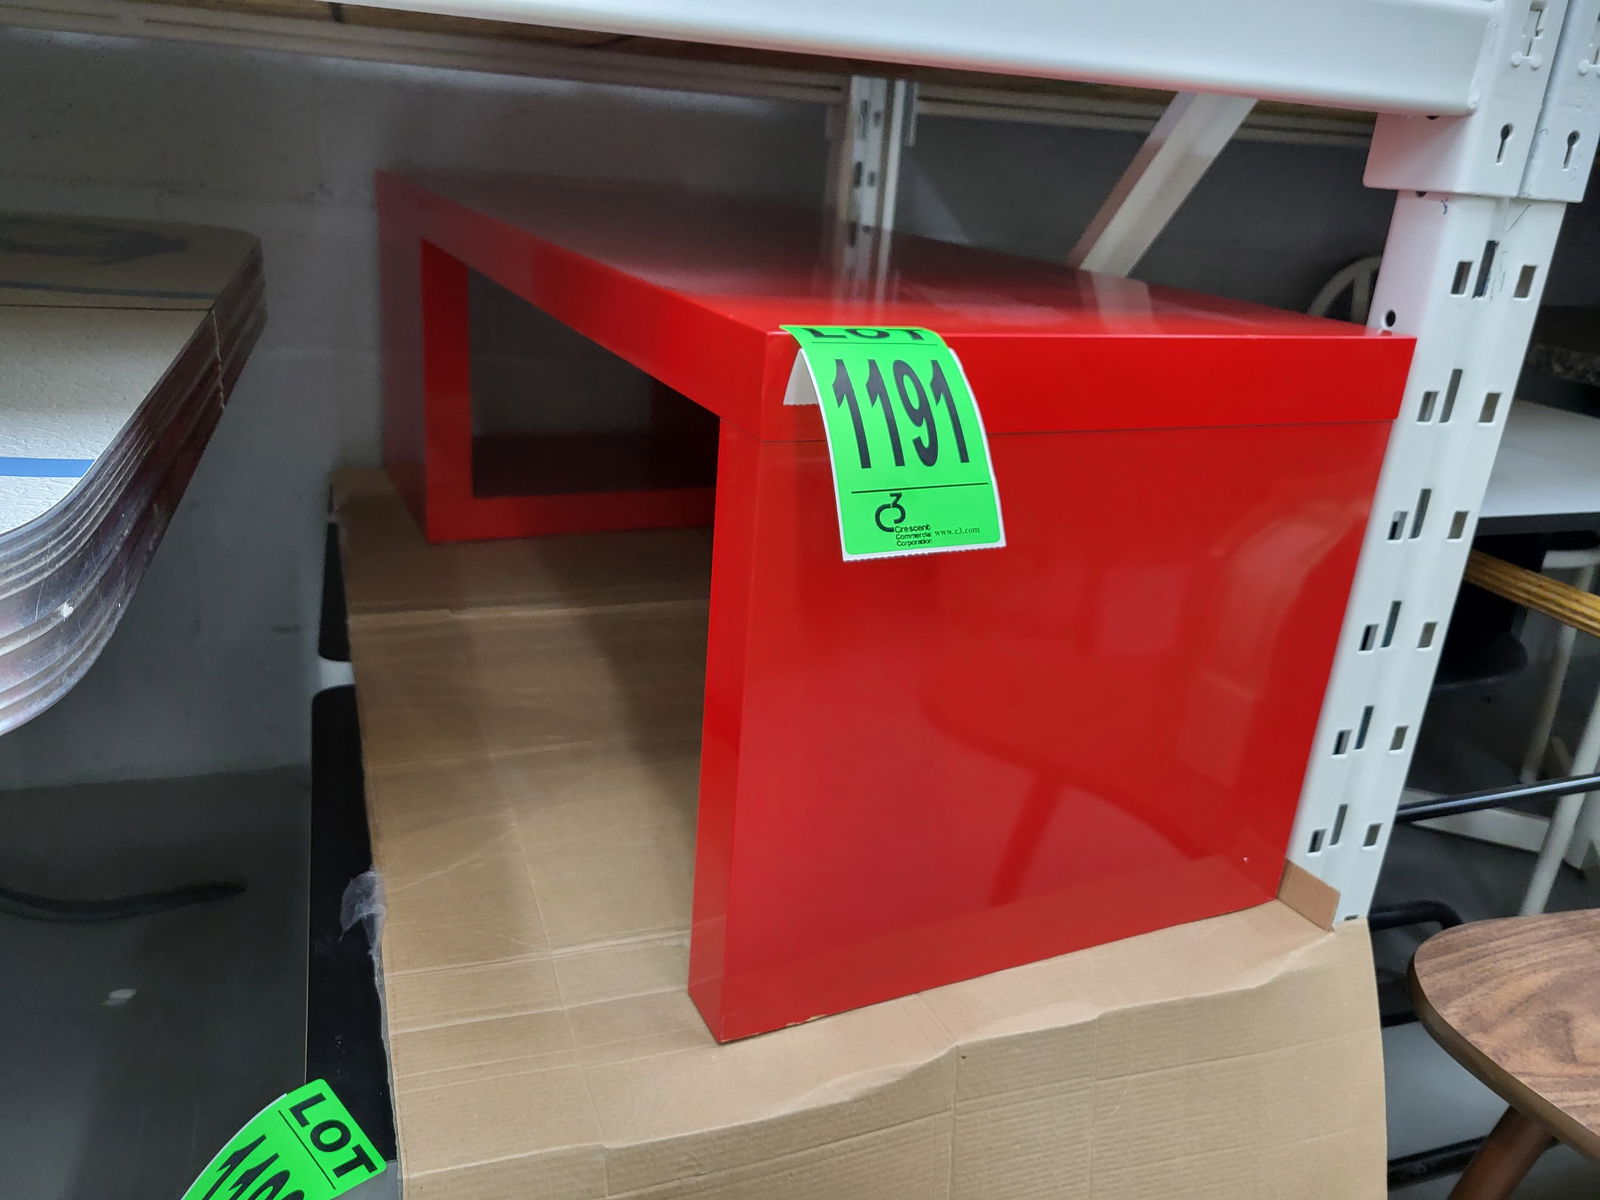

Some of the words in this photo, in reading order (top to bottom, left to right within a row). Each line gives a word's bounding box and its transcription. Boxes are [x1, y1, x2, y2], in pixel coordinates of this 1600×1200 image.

[801, 327, 925, 341] LOT
[832, 358, 970, 469] 1191
[894, 524, 931, 534] Crescent
[934, 526, 980, 536] www.c3.com
[895, 532, 932, 540] Commercial
[896, 538, 933, 547] Corporation
[288, 1092, 378, 1179] LOT
